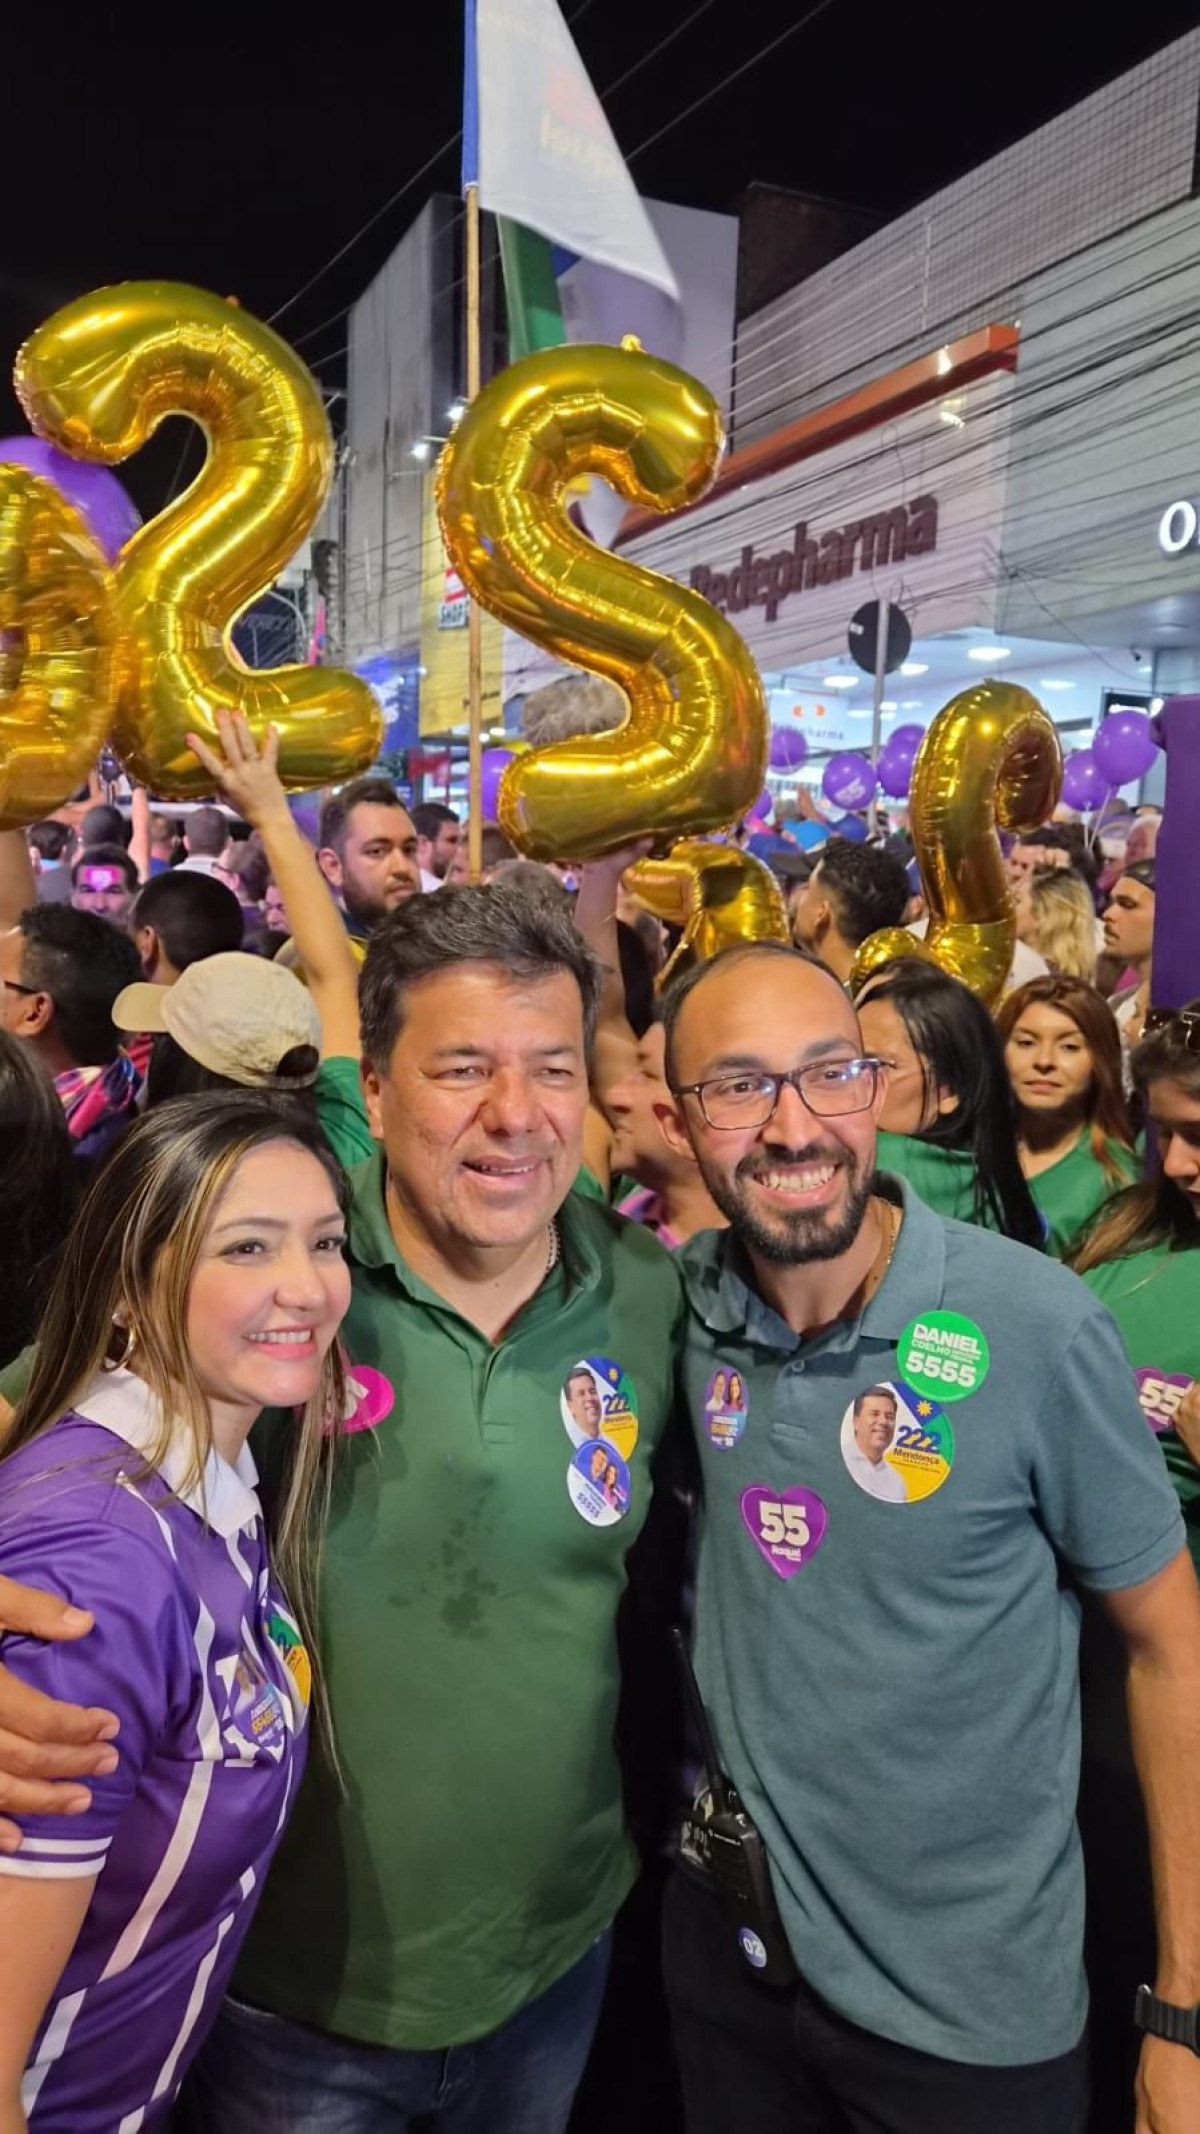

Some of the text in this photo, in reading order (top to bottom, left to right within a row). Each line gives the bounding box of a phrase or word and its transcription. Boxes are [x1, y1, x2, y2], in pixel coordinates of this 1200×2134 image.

[690, 494, 937, 622] Redepharma
[911, 1339, 951, 1356] COELHO
[913, 1323, 982, 1355] DANIEL
[905, 1350, 977, 1388] 5555
[602, 1393, 631, 1416] 222
[1139, 1377, 1185, 1416] 55
[893, 1447, 940, 1465] Mendonça
[896, 1424, 942, 1456] 222
[759, 1500, 810, 1547] 55
